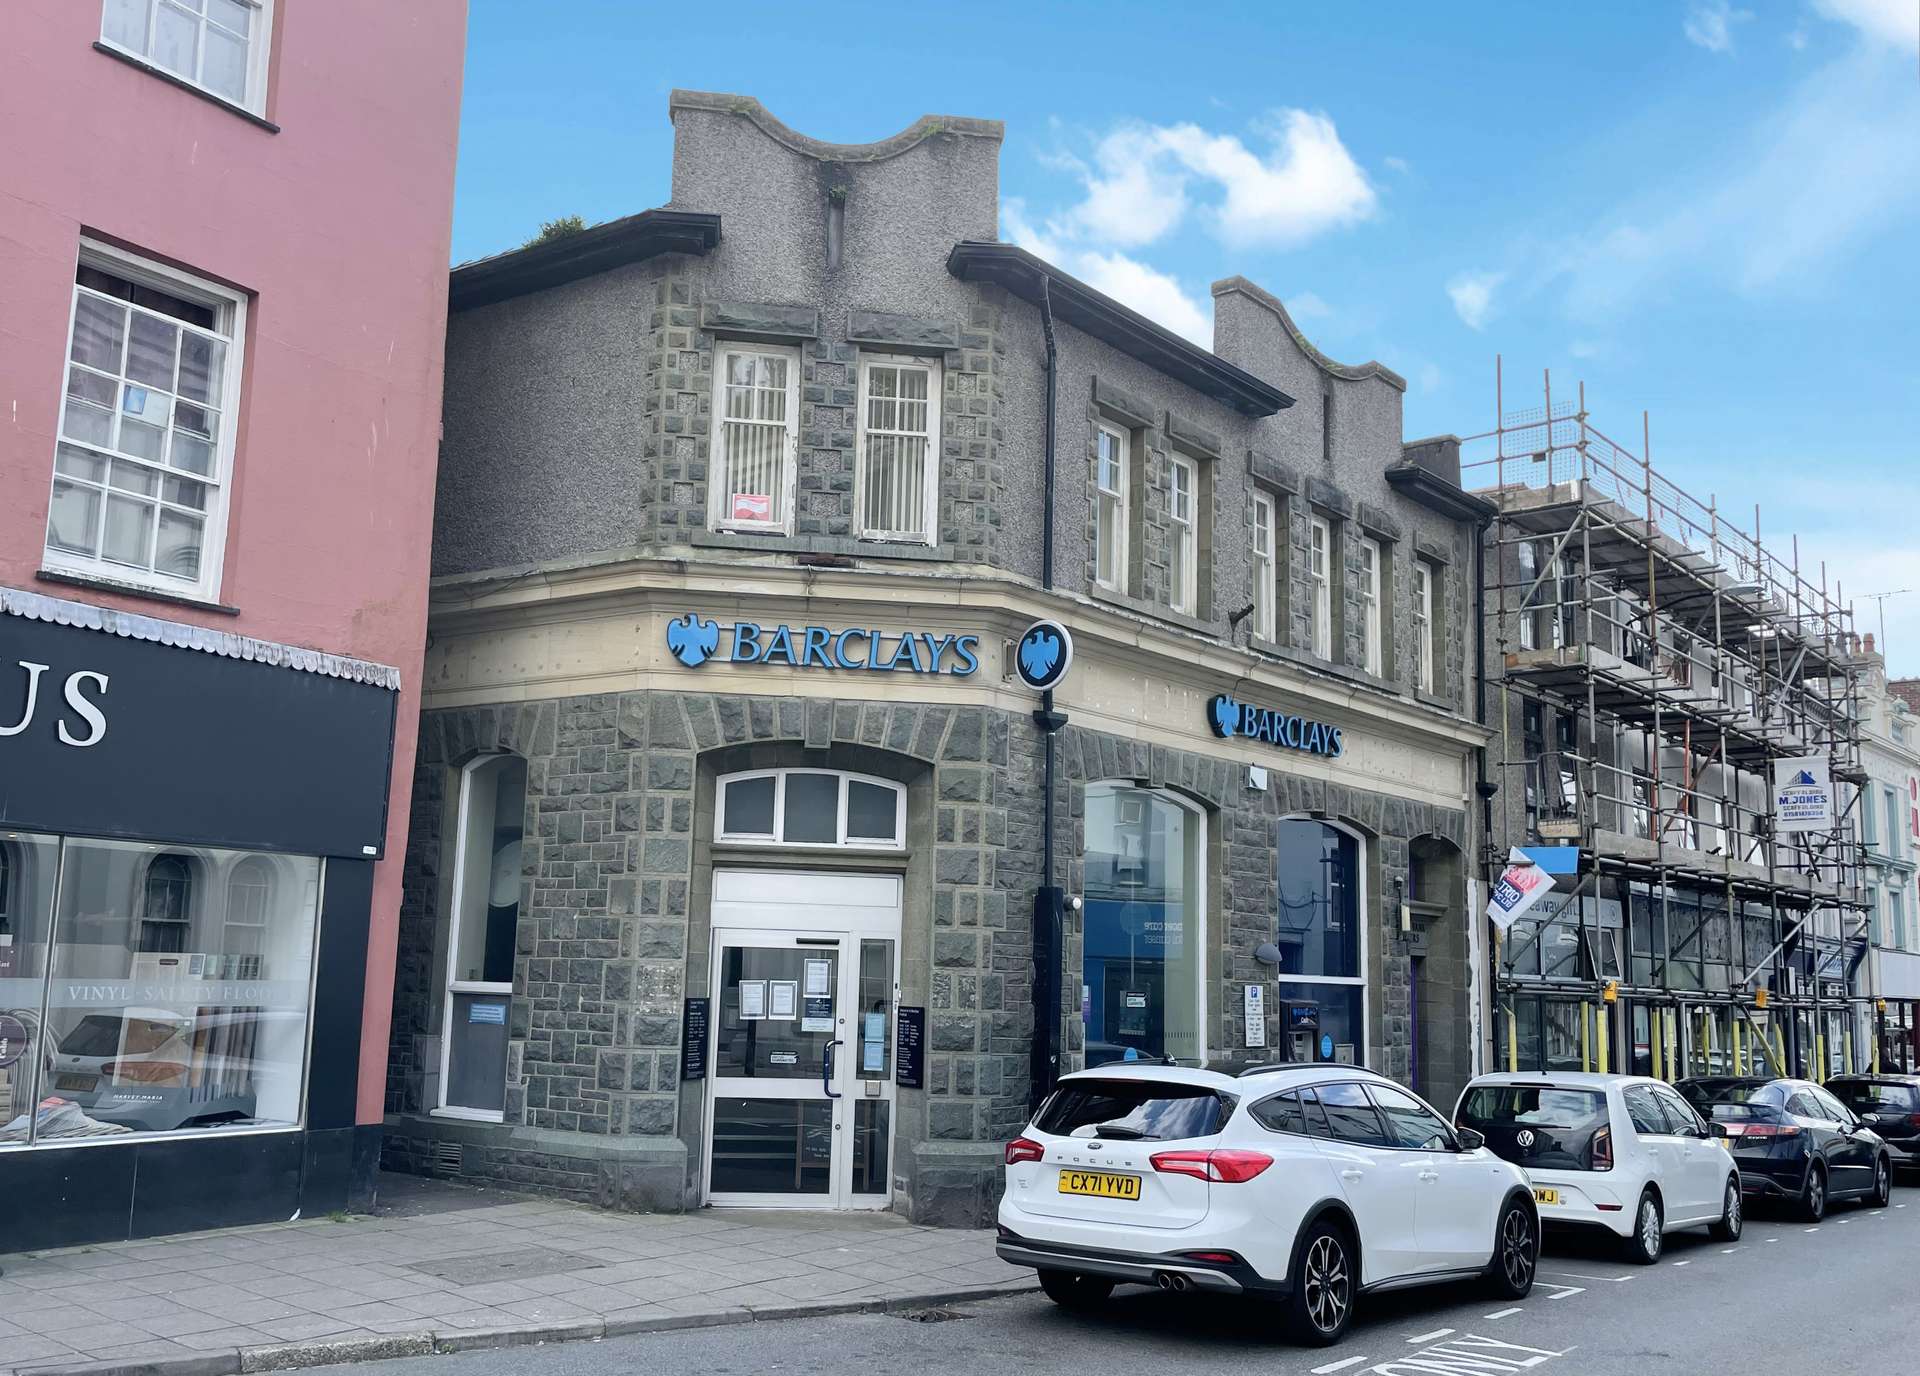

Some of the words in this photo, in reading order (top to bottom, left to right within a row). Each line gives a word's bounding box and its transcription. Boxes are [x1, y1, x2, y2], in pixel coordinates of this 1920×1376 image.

[730, 622, 980, 676] BARCLAYS
[1243, 703, 1343, 757] BARCLAYS
[1779, 795, 1827, 805] M.JONES
[1498, 881, 1520, 902] TRIO
[69, 985, 129, 1000] VINYL
[1057, 1155, 1132, 1166] FOCUS
[1071, 1174, 1102, 1192] CX71
[1106, 1176, 1134, 1194] YVD
